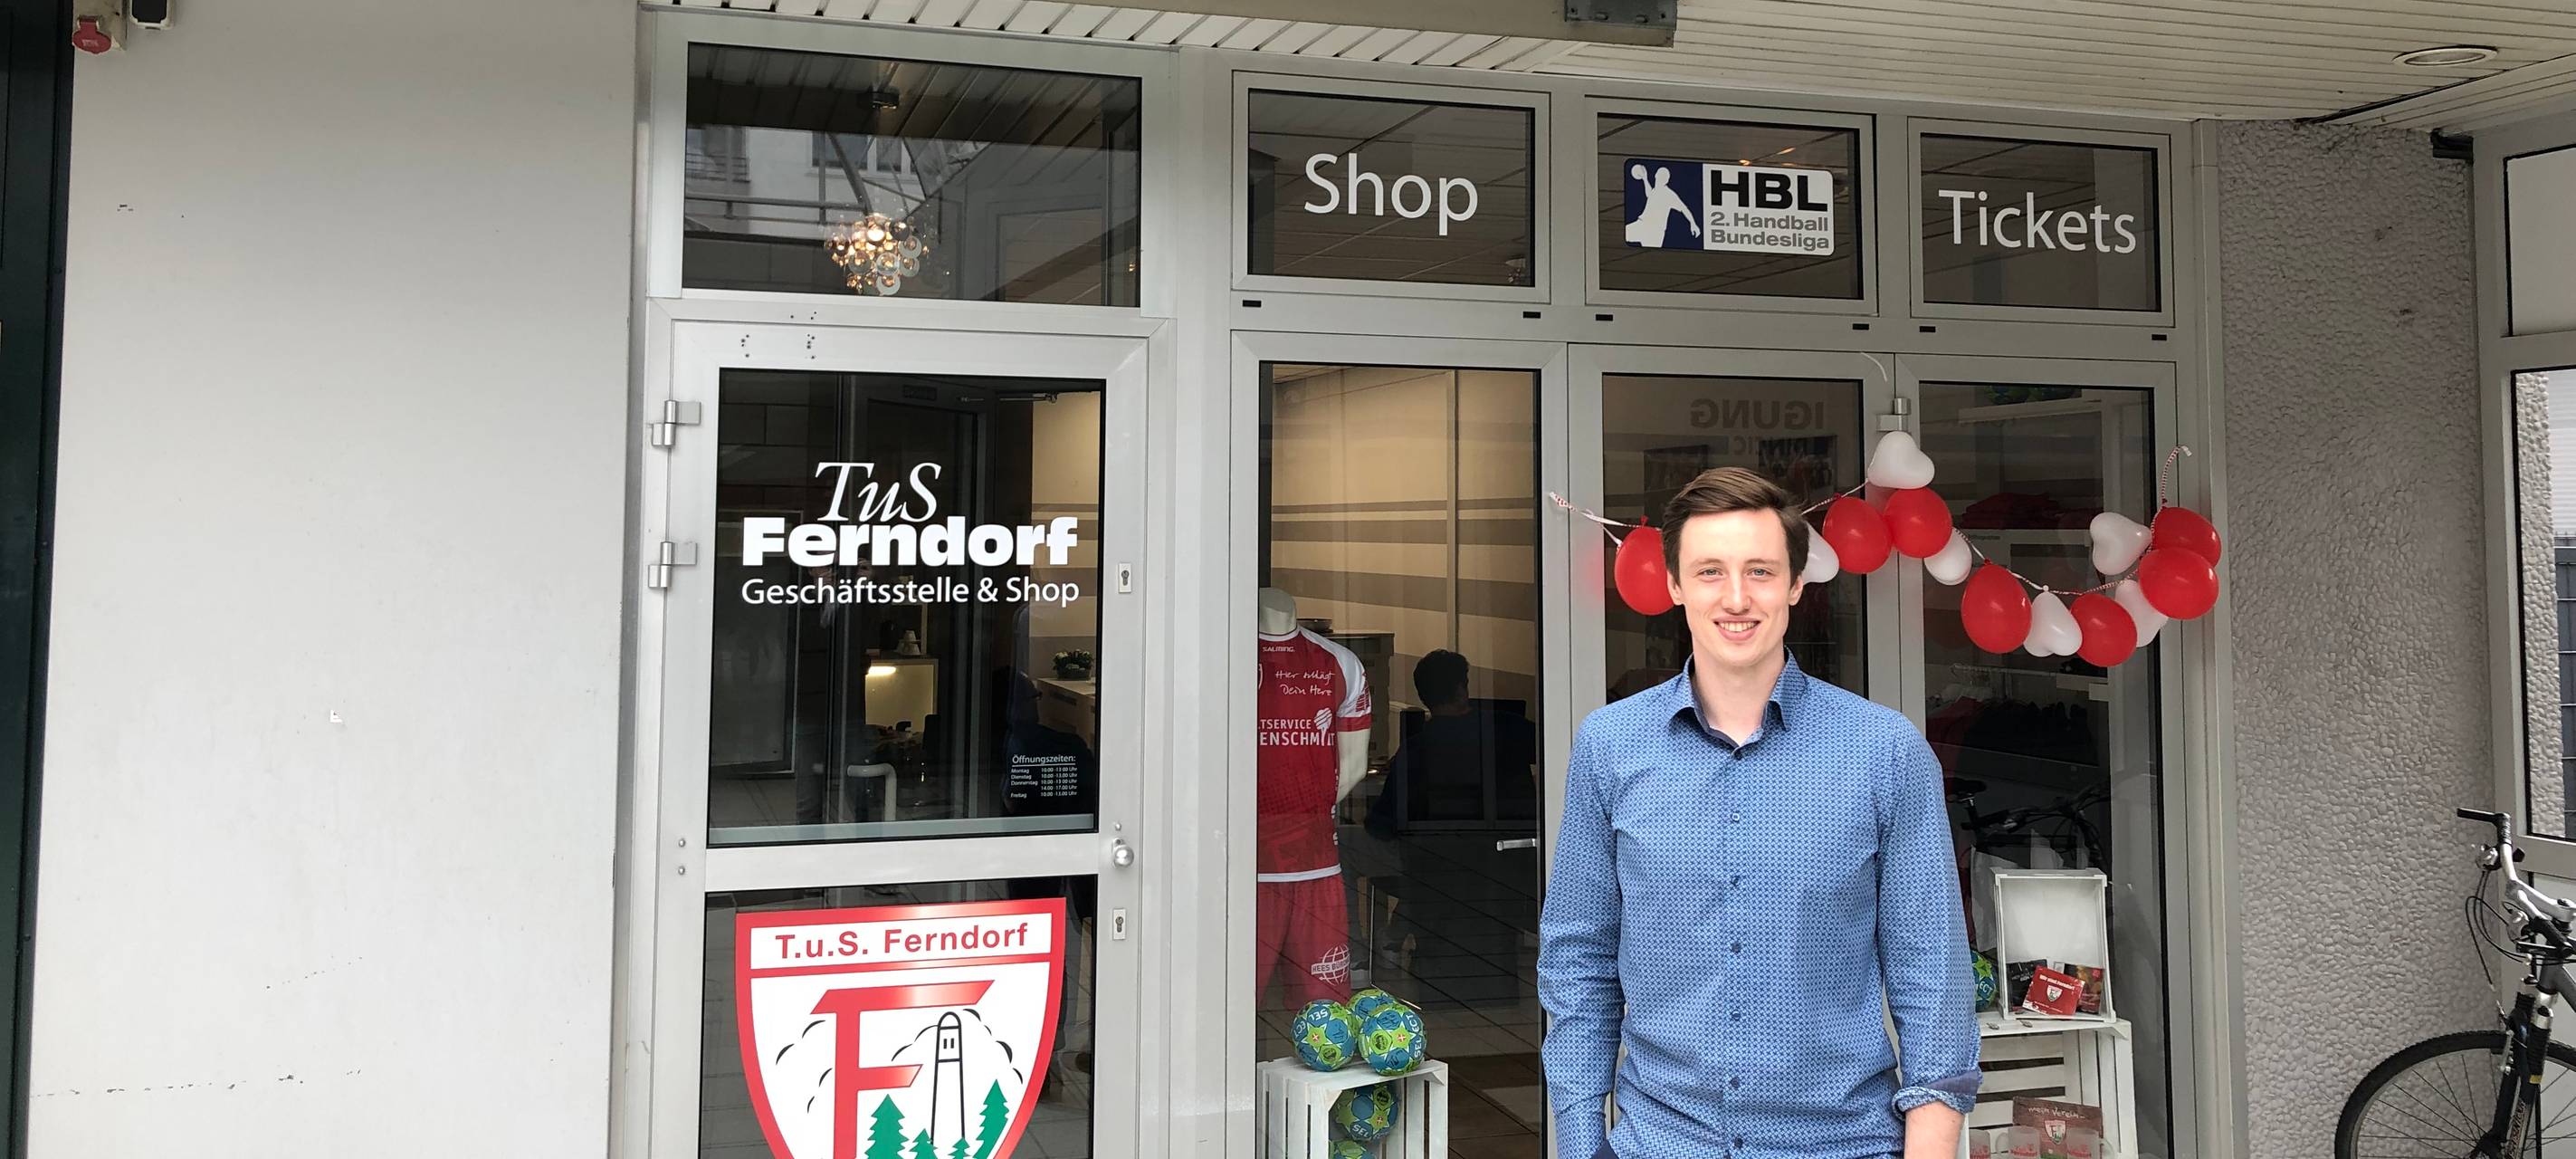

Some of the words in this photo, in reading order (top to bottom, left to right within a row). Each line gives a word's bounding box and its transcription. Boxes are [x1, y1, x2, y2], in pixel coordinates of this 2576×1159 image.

[1304, 152, 1478, 236] Shop
[1709, 169, 1828, 212] HBL
[1710, 211, 1730, 226] 2.
[1733, 213, 1828, 232] Handball
[1939, 188, 2137, 254] Tickets
[1711, 229, 1829, 252] Bundesliga
[815, 462, 942, 522] TuS
[742, 515, 1078, 567] Ferndorf
[741, 577, 969, 604] Geschäftsstelle
[977, 578, 998, 602] &
[1006, 576, 1080, 608] Shop
[1275, 670, 1300, 680] Hier
[1280, 684, 1306, 694] Dein
[1310, 684, 1332, 696] Herz
[1258, 719, 1312, 730] TSERVICE
[1012, 754, 1076, 764] Öffnungszeiten:
[775, 931, 869, 959] T.u.S.
[884, 922, 1028, 953] Ferndorf
[1312, 964, 1331, 973] HEES
